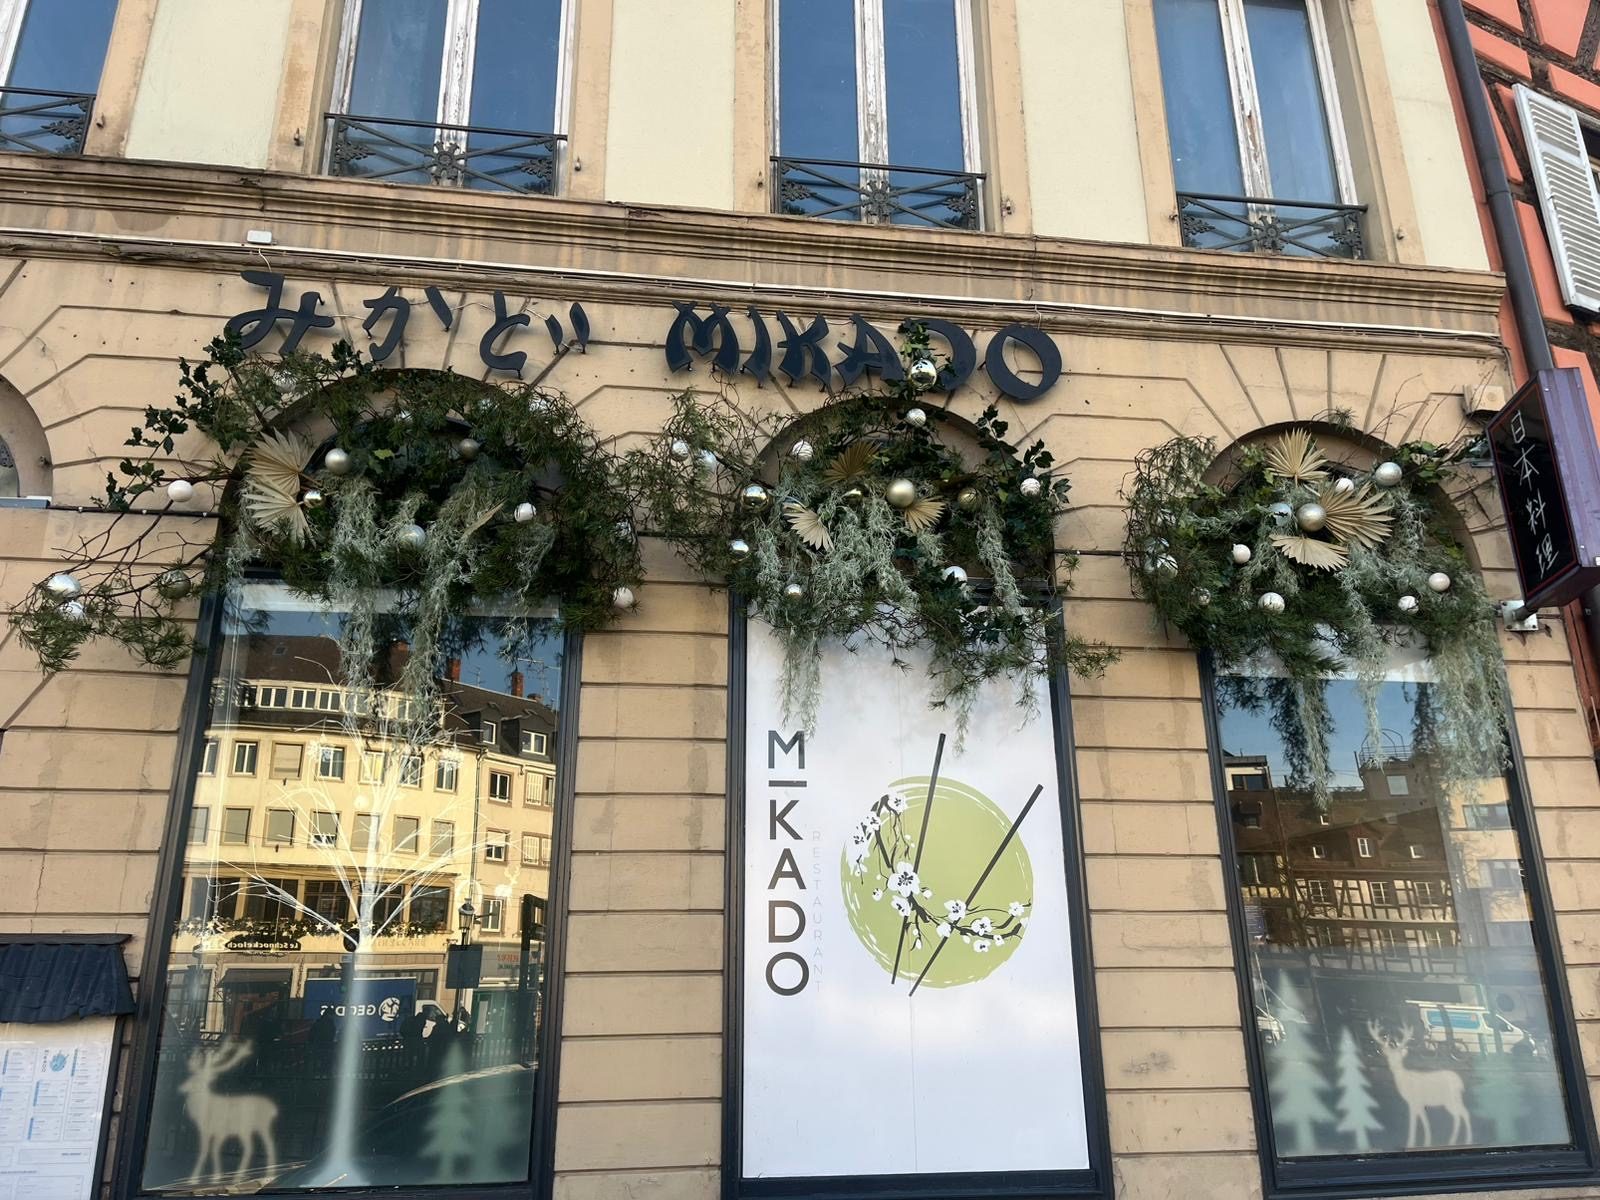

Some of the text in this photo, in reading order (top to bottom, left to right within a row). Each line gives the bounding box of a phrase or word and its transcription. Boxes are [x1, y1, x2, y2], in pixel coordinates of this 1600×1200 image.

[225, 270, 591, 372] みかど
[666, 299, 1062, 401] MIKADO
[1510, 409, 1559, 580] 日本料理
[766, 729, 810, 997] MIKADO
[811, 830, 824, 993] RESTAURANT
